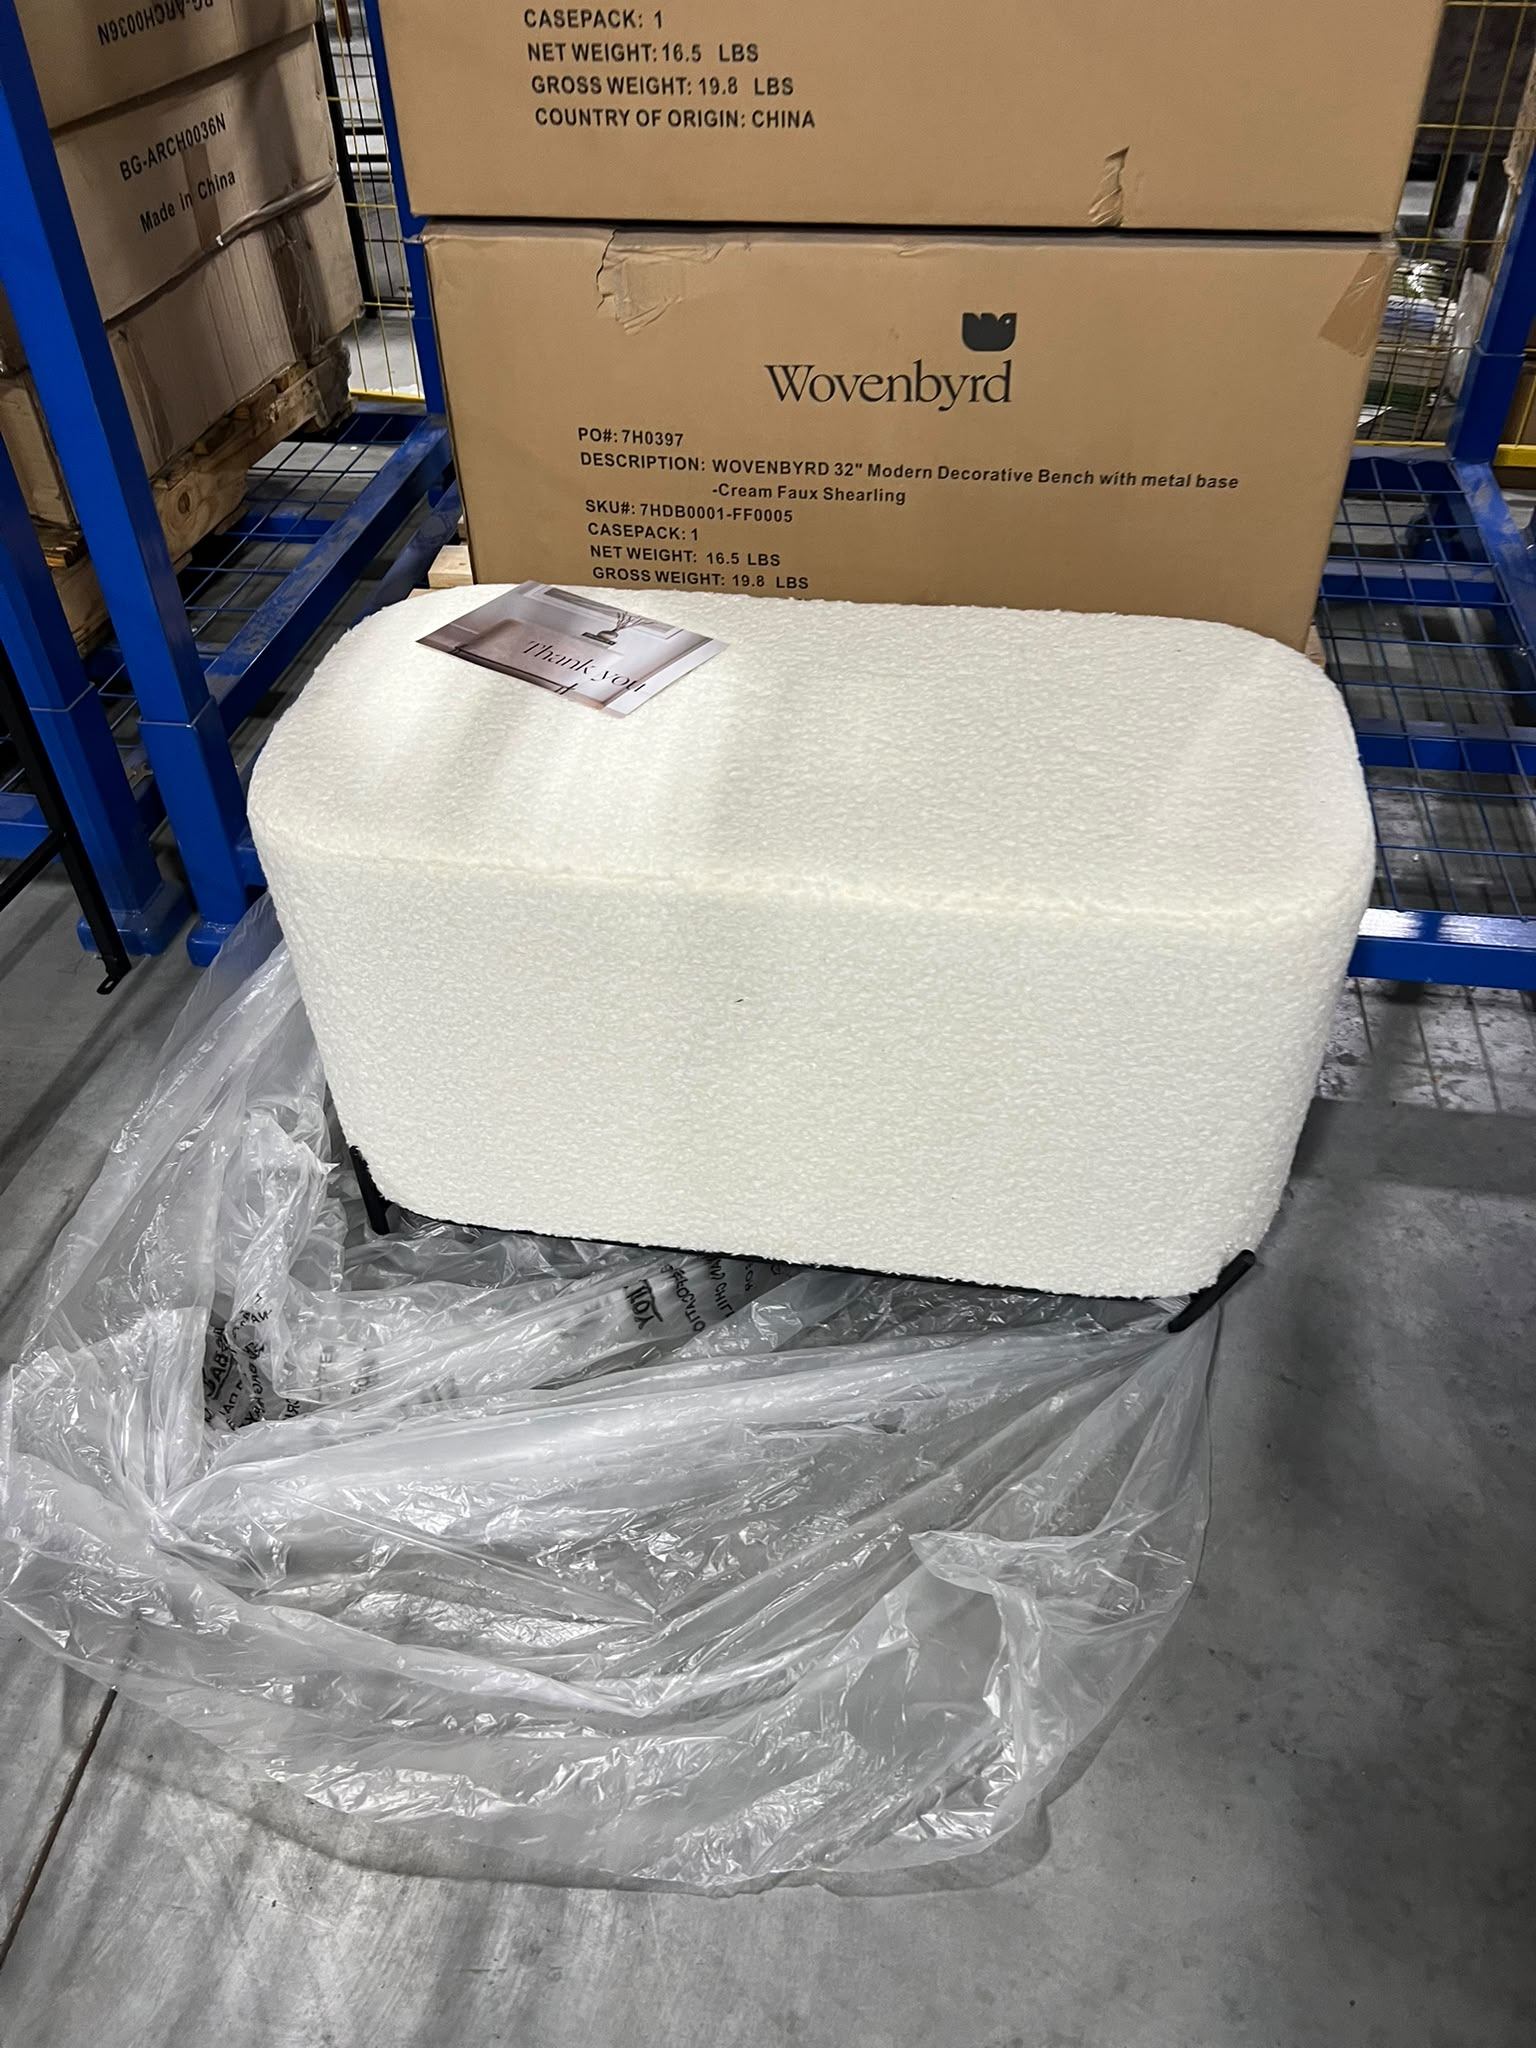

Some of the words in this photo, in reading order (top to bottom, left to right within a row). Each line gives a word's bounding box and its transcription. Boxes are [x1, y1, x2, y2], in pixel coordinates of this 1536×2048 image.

[523, 8, 643, 29] CASEPACK:
[654, 9, 662, 29] 1
[527, 42, 567, 62] NET
[571, 42, 657, 63] WEIGHT:
[662, 42, 702, 63] 16.5
[718, 43, 759, 63] LBS
[531, 75, 602, 95] GROSS
[606, 76, 692, 96] WEIGHT:
[698, 76, 738, 96] 19.8
[754, 76, 794, 96] LBS
[535, 107, 631, 127] COUNTRY
[635, 109, 662, 127] OF
[667, 109, 746, 129] ORIGIN:
[751, 109, 816, 129] CHINA
[119, 112, 226, 182] BG-ARCH0036N
[139, 203, 176, 233] Made
[180, 194, 193, 210] in
[197, 171, 236, 201] China
[764, 358, 1012, 412] Wovenbyrd
[578, 427, 618, 443] PO#:
[621, 429, 684, 447] 7H0397
[580, 451, 705, 472] DESCRIPTION:
[711, 459, 830, 476] WOVENBYRD
[834, 462, 863, 477] 32"
[867, 463, 933, 479] Modern
[937, 465, 1033, 483] Decorative
[1037, 468, 1095, 485] Bench
[1099, 471, 1137, 486] with
[1141, 473, 1192, 488] metal
[1195, 473, 1239, 489] base
[712, 482, 773, 499] -Cream
[777, 485, 818, 500] Faux
[823, 486, 906, 506] Shearling
[585, 499, 636, 515] SKU#:
[638, 502, 795, 525] 7HDB0001-FF0005
[587, 522, 686, 541] CASEPACK:
[690, 527, 698, 541] 1
[590, 544, 623, 559] NET
[626, 546, 697, 563] WEIGHT:
[706, 551, 740, 565] 16.5
[747, 552, 781, 567] LBS
[592, 566, 652, 582] GROSS
[654, 570, 725, 586] WEIGHT:
[732, 574, 765, 588] 19.8
[776, 576, 809, 590] LBS
[523, 641, 595, 675] Thank
[590, 669, 647, 693] you
